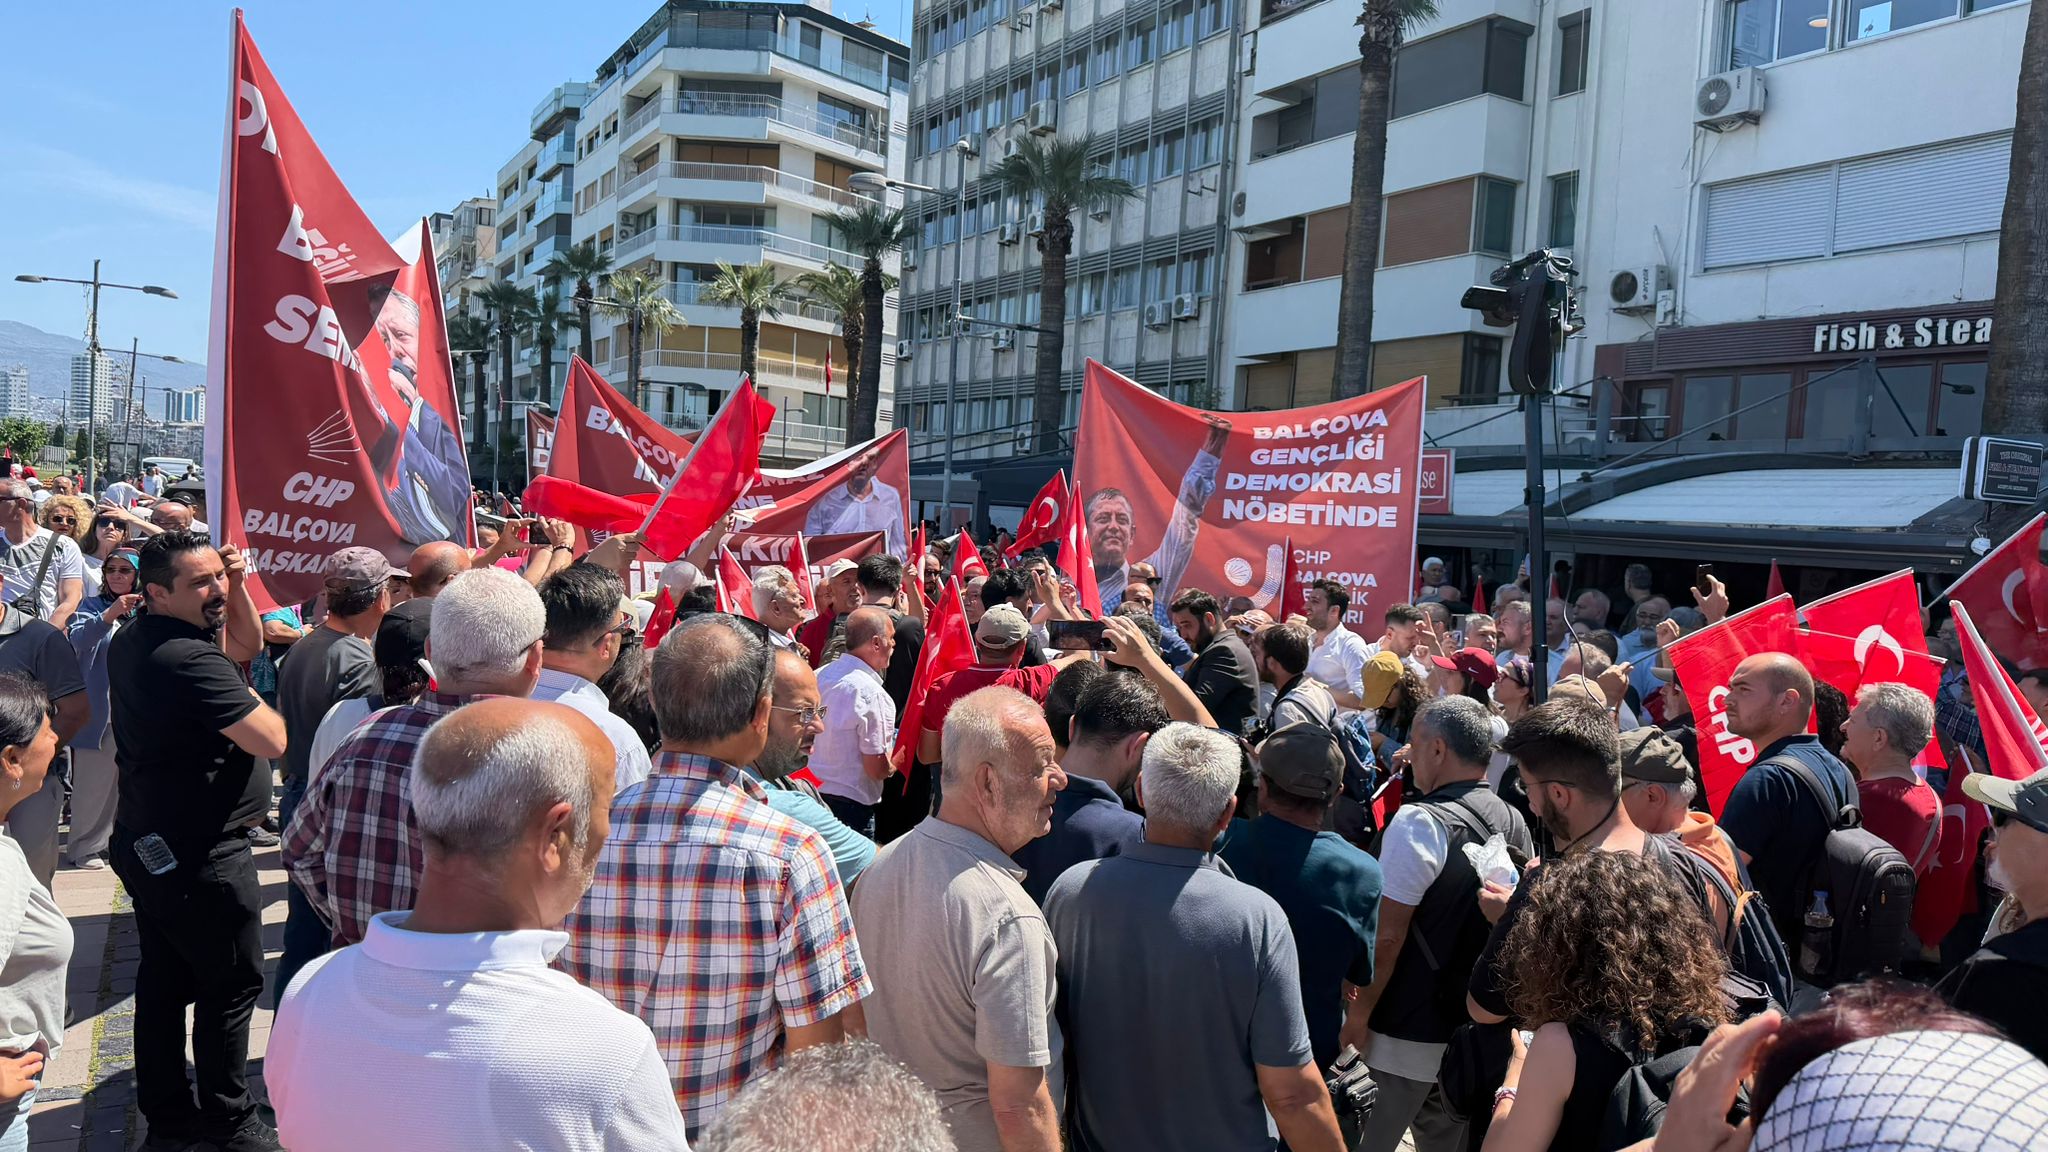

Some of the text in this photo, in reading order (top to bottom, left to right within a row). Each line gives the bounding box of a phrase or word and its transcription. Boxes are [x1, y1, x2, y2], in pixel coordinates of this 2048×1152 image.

[1814, 317, 1993, 353] Fish & Stea
[1252, 409, 1389, 439] BALÇOVA
[1250, 433, 1385, 466] GENÇLİĞİ
[283, 471, 355, 508] CHP
[1225, 468, 1402, 493] DEMOKRASİ
[244, 508, 356, 544] BALÇOVA
[1222, 496, 1398, 527] NÖBETİNDE
[1293, 549, 1331, 564] CHP
[1708, 685, 1755, 764] CHP
